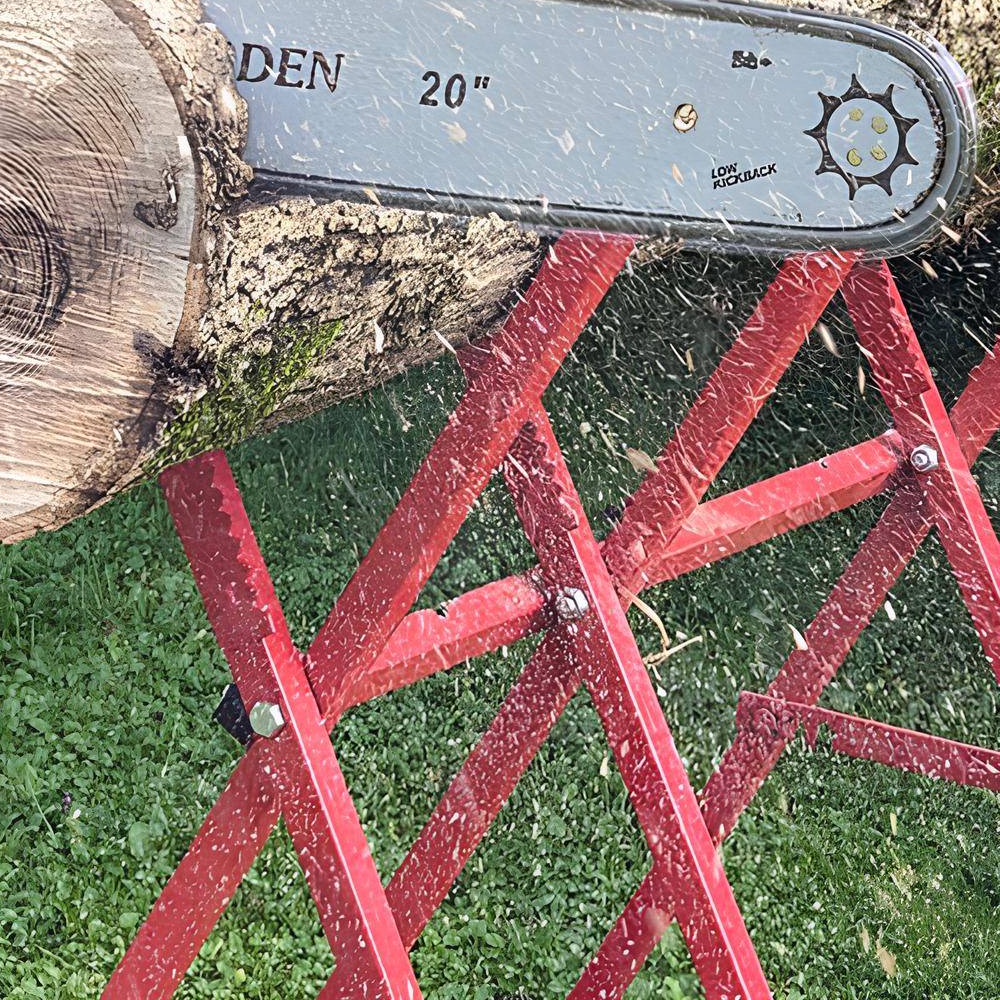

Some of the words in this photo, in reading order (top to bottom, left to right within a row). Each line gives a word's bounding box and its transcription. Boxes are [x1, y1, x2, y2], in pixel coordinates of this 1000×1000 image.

[236, 43, 345, 93] DEN
[419, 71, 490, 109] 20"
[711, 162, 738, 179] LOW
